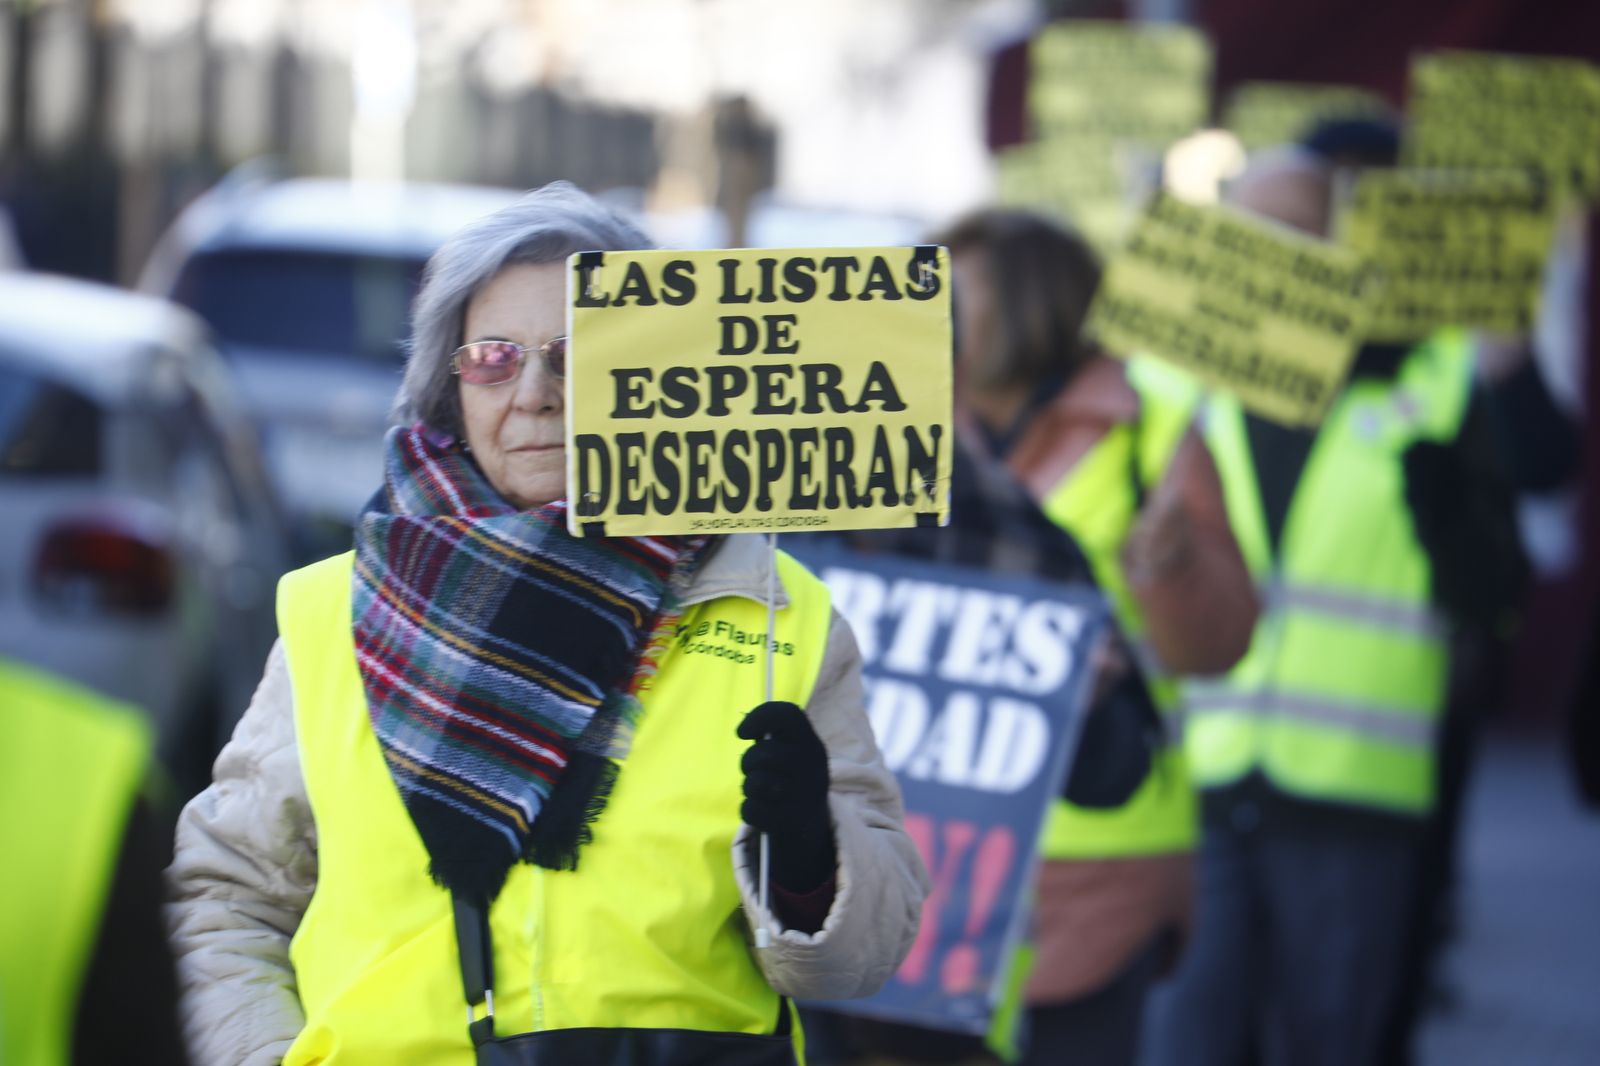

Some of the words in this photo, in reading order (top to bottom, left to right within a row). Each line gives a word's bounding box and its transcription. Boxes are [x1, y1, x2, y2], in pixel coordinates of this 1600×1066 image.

[574, 260, 697, 307] LAS
[718, 255, 942, 304] LISTAS
[717, 314, 799, 355] DE
[610, 360, 907, 419] ESPERA
[575, 424, 942, 517] DESESPERAN
